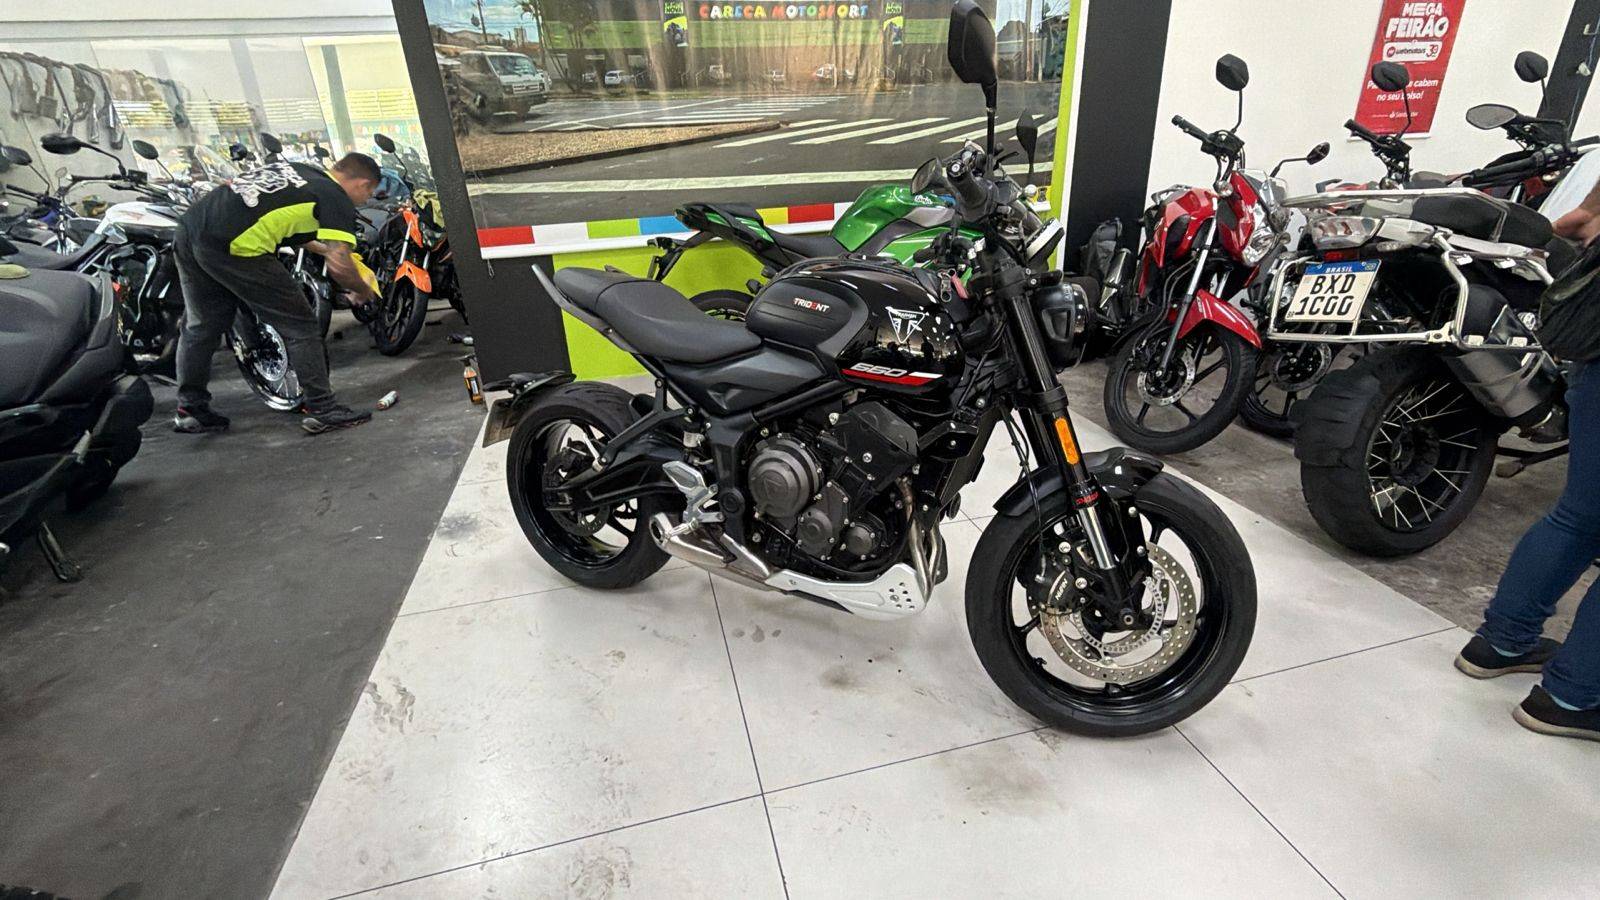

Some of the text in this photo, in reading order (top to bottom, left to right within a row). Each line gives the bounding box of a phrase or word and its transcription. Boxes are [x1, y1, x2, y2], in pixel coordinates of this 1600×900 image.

[699, 5, 767, 19] CARECA
[1402, 3, 1443, 16] MEGA
[1386, 15, 1449, 38] FEIRÃO
[1414, 78, 1438, 87] cabem
[1387, 92, 1401, 100] seu
[1310, 274, 1357, 295] BXD
[794, 298, 830, 312] TRIDENT
[850, 362, 907, 377] 660
